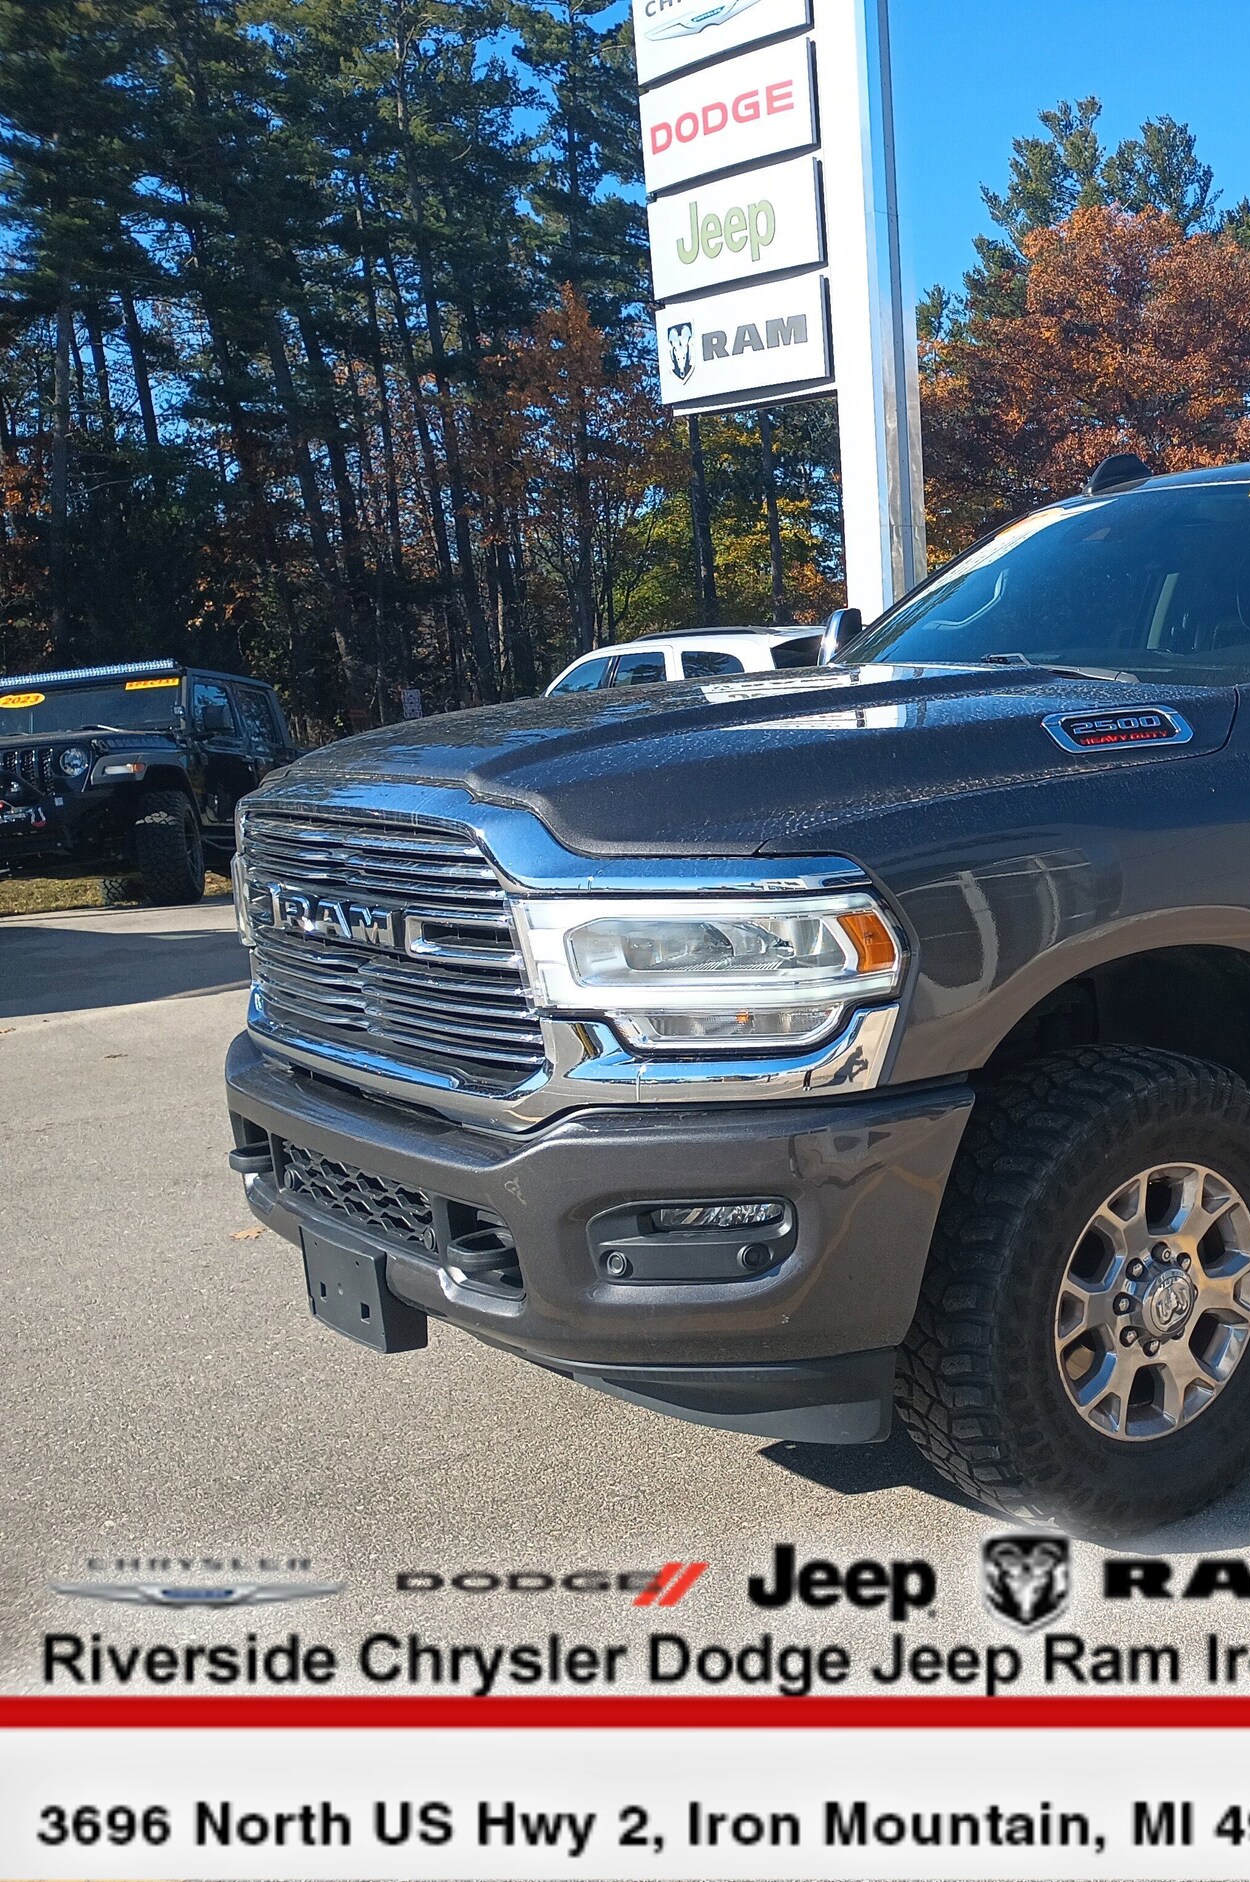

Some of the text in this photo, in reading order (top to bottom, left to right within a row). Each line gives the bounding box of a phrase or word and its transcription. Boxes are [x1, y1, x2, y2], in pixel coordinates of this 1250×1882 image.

[650, 79, 795, 155] DODGE
[676, 199, 777, 265] Jeep
[701, 313, 808, 362] RAM
[2, 694, 41, 705] 2023
[1071, 715, 1161, 735] 2500
[1080, 730, 1168, 745] HEAVY DUTY
[266, 882, 403, 950] RAM
